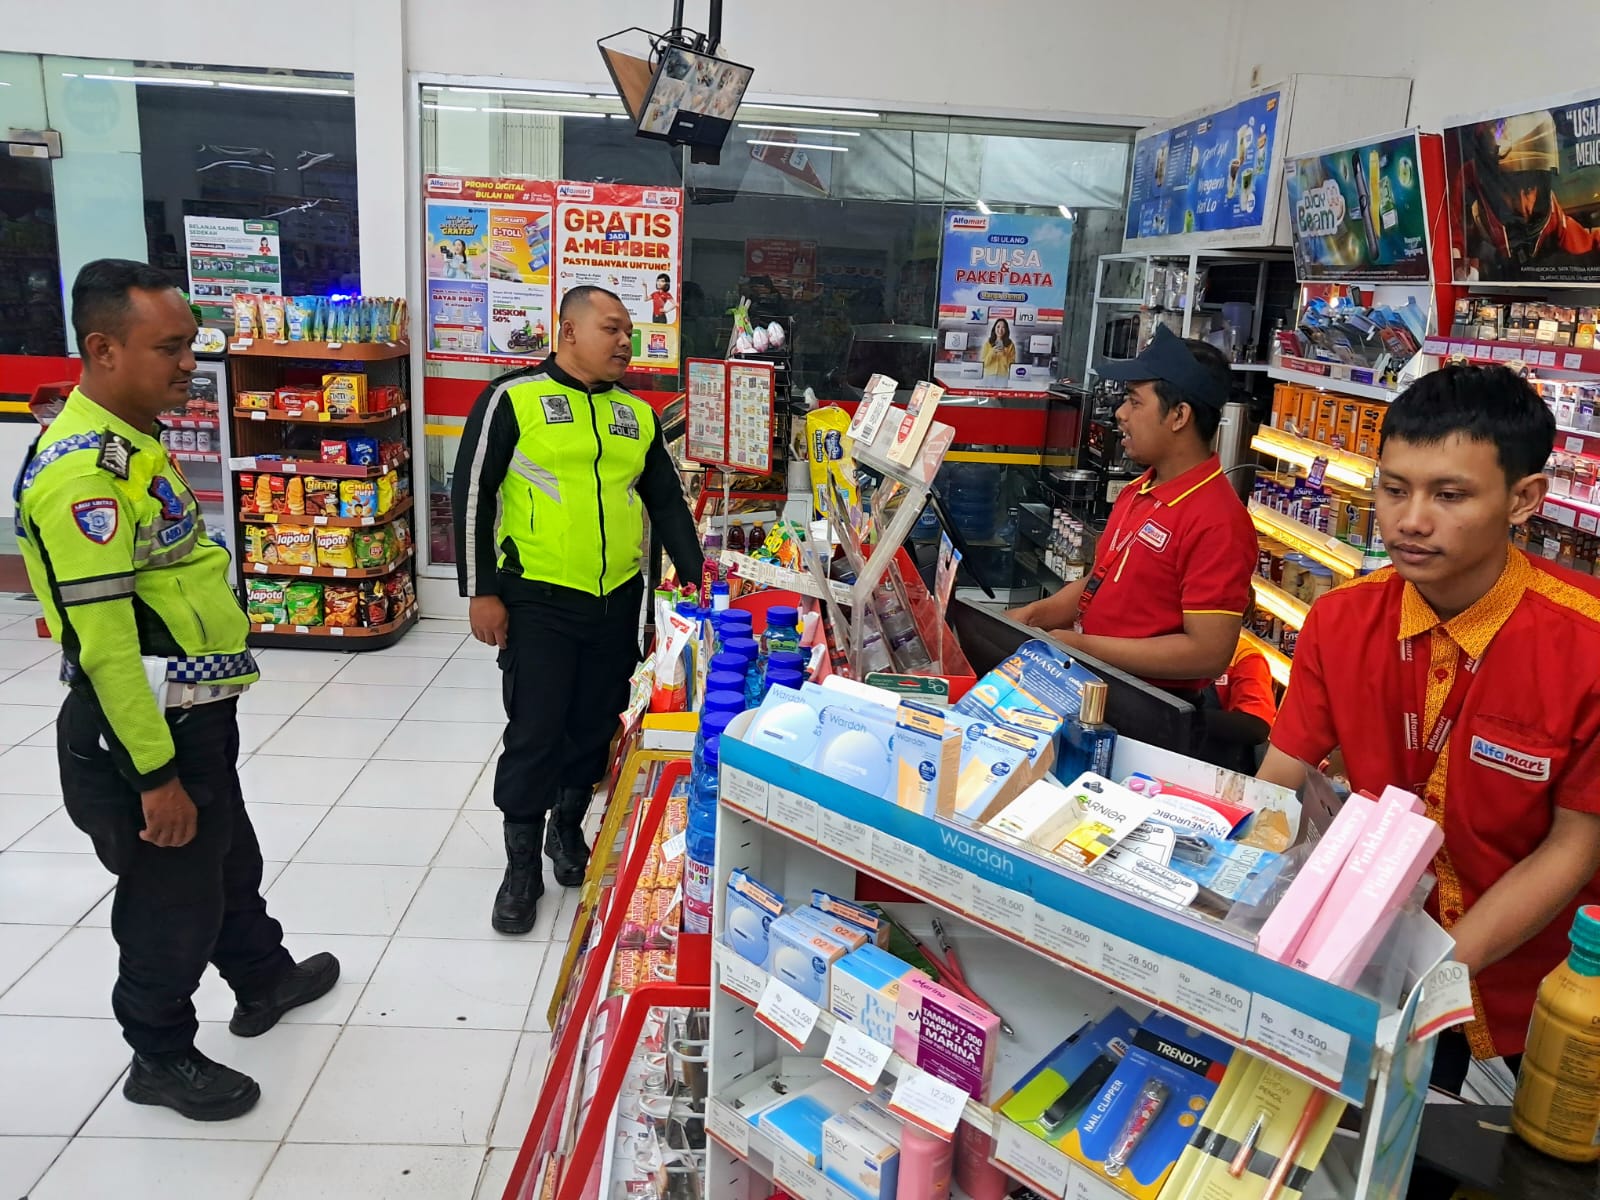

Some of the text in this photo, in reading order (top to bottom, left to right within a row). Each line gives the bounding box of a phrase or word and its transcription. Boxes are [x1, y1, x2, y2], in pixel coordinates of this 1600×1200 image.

[465, 181, 525, 191] PROMO DIGITAL
[476, 191, 502, 199] BULAN
[564, 208, 672, 238] GRATIS
[953, 216, 987, 225] Alfamart
[1298, 206, 1335, 232] Beam
[493, 229, 522, 237] E-TOLL
[563, 257, 671, 271] PASTI BANYAK UNTUNG!
[970, 247, 1041, 269] PULSA
[1000, 263, 1010, 272] &
[956, 270, 1053, 287] PAKET DATA
[493, 309, 526, 317] DISKON
[277, 533, 311, 548] Japota
[249, 590, 283, 602] Japota
[1284, 631, 1299, 640] Ens
[772, 687, 806, 704] Wardah
[927, 679, 945, 694] 50
[829, 714, 866, 733] Wardah
[897, 732, 927, 748] Wardah
[1426, 716, 1447, 751] Alfamart
[1474, 740, 1545, 772] Alfamart
[1153, 809, 1206, 831] NEUROBIC
[940, 828, 1014, 875] Wardah
[689, 862, 710, 875] HYDRO
[1061, 924, 1090, 943] 28.500
[1128, 953, 1159, 973] 28.500
[1179, 971, 1190, 983] Rp
[1209, 987, 1243, 1009] 28.500
[922, 1017, 981, 1056] DAPAT 2 PCS
[923, 1008, 983, 1047] TAMBAH 7.000
[1260, 1012, 1328, 1051] Rp 43.500
[925, 1028, 976, 1063] MARINA
[1157, 1041, 1203, 1068] TRENDY
[931, 1088, 955, 1104] 12.200
[1083, 1080, 1124, 1133] NAIL CLIPPER
